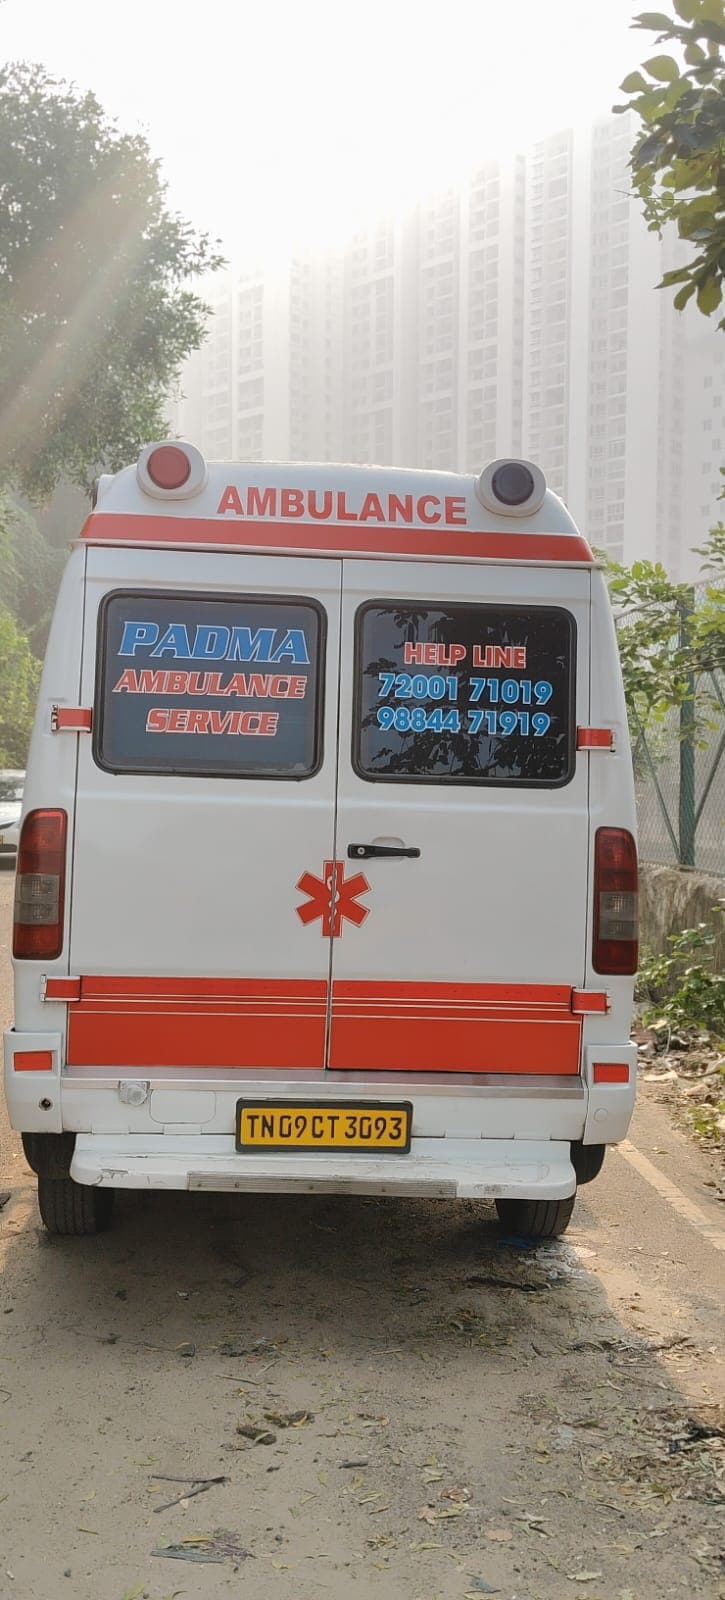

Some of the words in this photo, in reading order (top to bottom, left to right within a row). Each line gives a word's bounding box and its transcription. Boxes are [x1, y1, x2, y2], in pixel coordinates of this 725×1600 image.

[217, 485, 467, 525] AMBULANCE
[117, 621, 311, 665] PADMA
[404, 642, 466, 667] HELP
[472, 645, 527, 669] LINE
[112, 669, 308, 699] AMBULANCE
[378, 672, 458, 701] 72001
[469, 677, 553, 706] 71019
[146, 708, 280, 737] SERVICE
[377, 706, 460, 734] 98844
[468, 709, 551, 737] 71919
